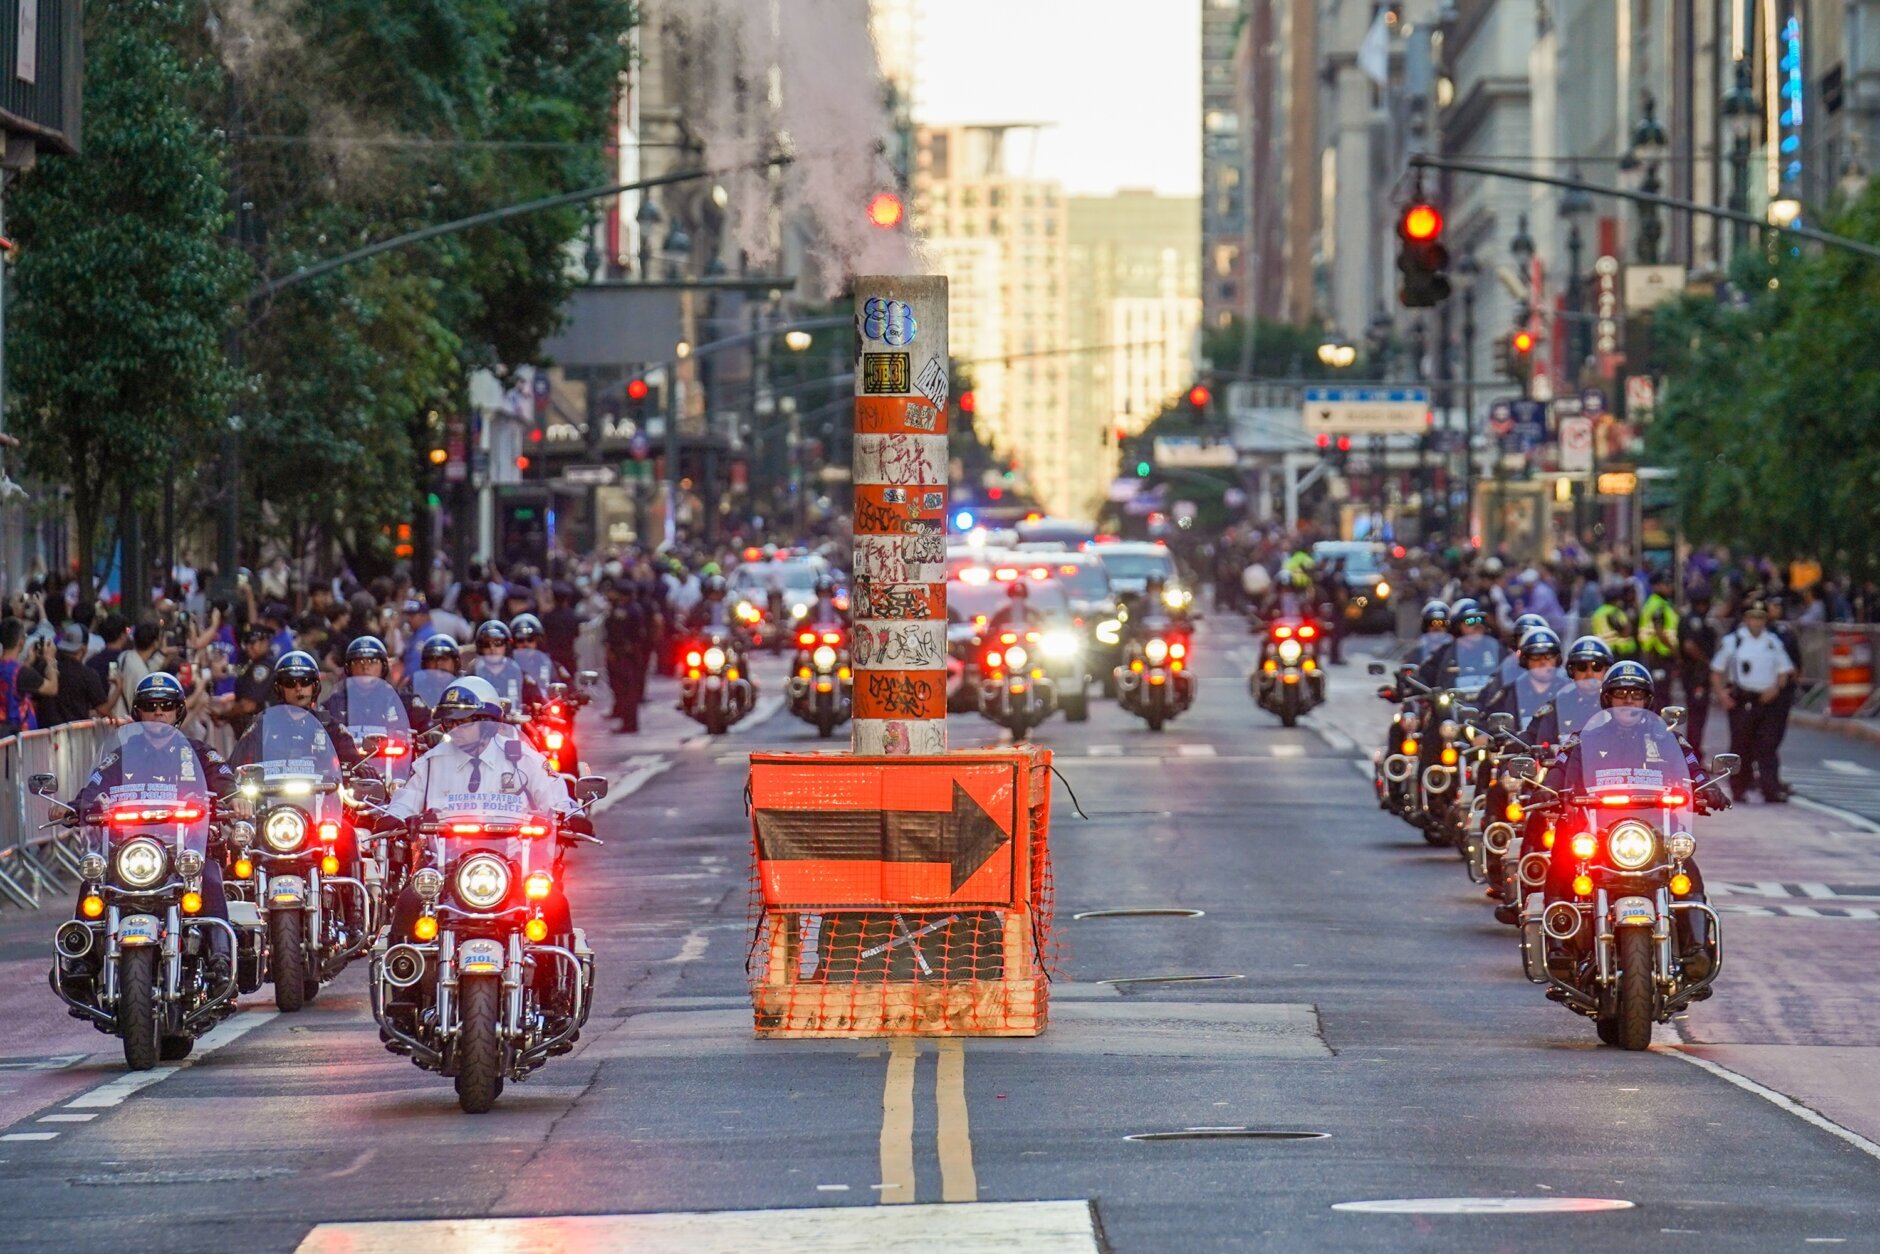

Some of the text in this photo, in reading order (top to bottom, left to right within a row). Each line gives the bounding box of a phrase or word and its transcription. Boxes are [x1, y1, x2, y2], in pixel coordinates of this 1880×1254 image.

[448, 793, 523, 804] HIGHWAY PATROL
[448, 802, 522, 813] NYPD POLICE
[465, 955, 490, 964] 2101
